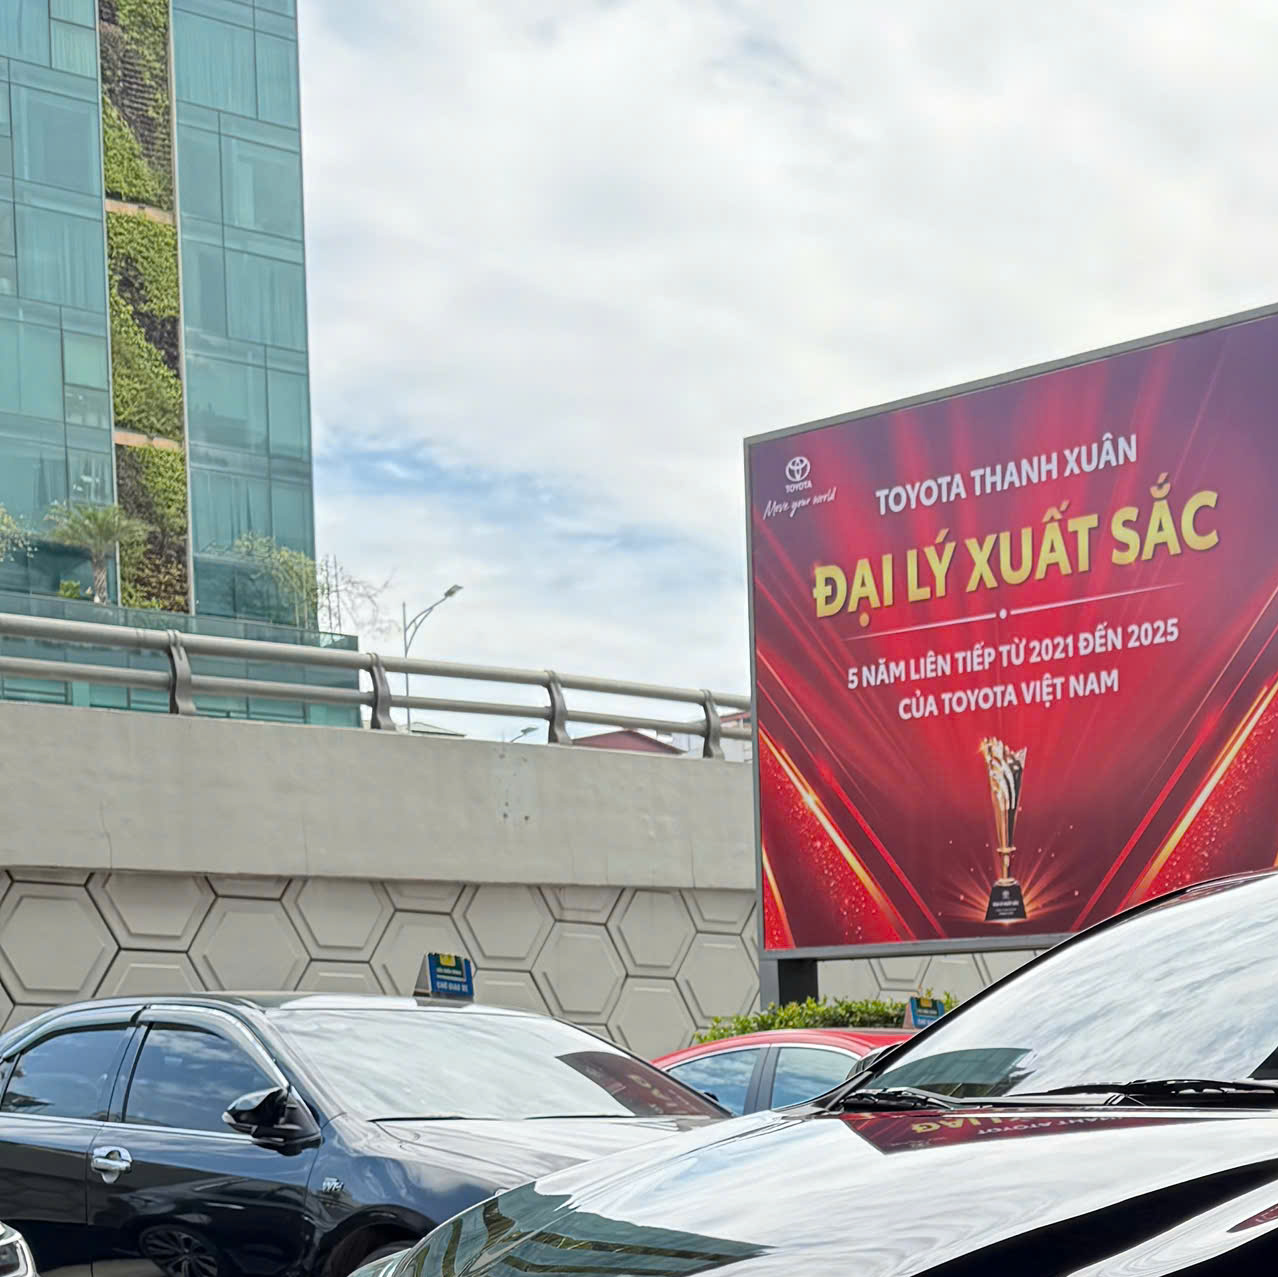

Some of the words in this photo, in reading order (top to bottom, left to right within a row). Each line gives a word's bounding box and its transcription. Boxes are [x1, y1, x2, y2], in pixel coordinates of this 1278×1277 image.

[785, 480, 813, 493] TOYOTA
[875, 473, 966, 515] TOYOTA
[971, 451, 1057, 496] THANH
[1063, 432, 1137, 477] XUÂN
[813, 554, 893, 628] ĐẠI
[906, 528, 956, 602] LÝ
[965, 500, 1099, 593] XUẤT
[1111, 472, 1220, 566] SẮC
[847, 668, 859, 689] 5
[862, 658, 906, 688] NĂM
[910, 650, 951, 681] LIÊN
[955, 642, 996, 674] TIẾP
[999, 637, 1028, 667] TỪ
[1029, 634, 1074, 664] 2021
[1078, 625, 1123, 656] ĐẾN
[1127, 618, 1179, 649] 2025
[898, 689, 938, 721] CỦA
[941, 684, 1018, 713] TOYOTA
[1021, 671, 1065, 708] VIỆT
[1069, 669, 1119, 698] NAM
